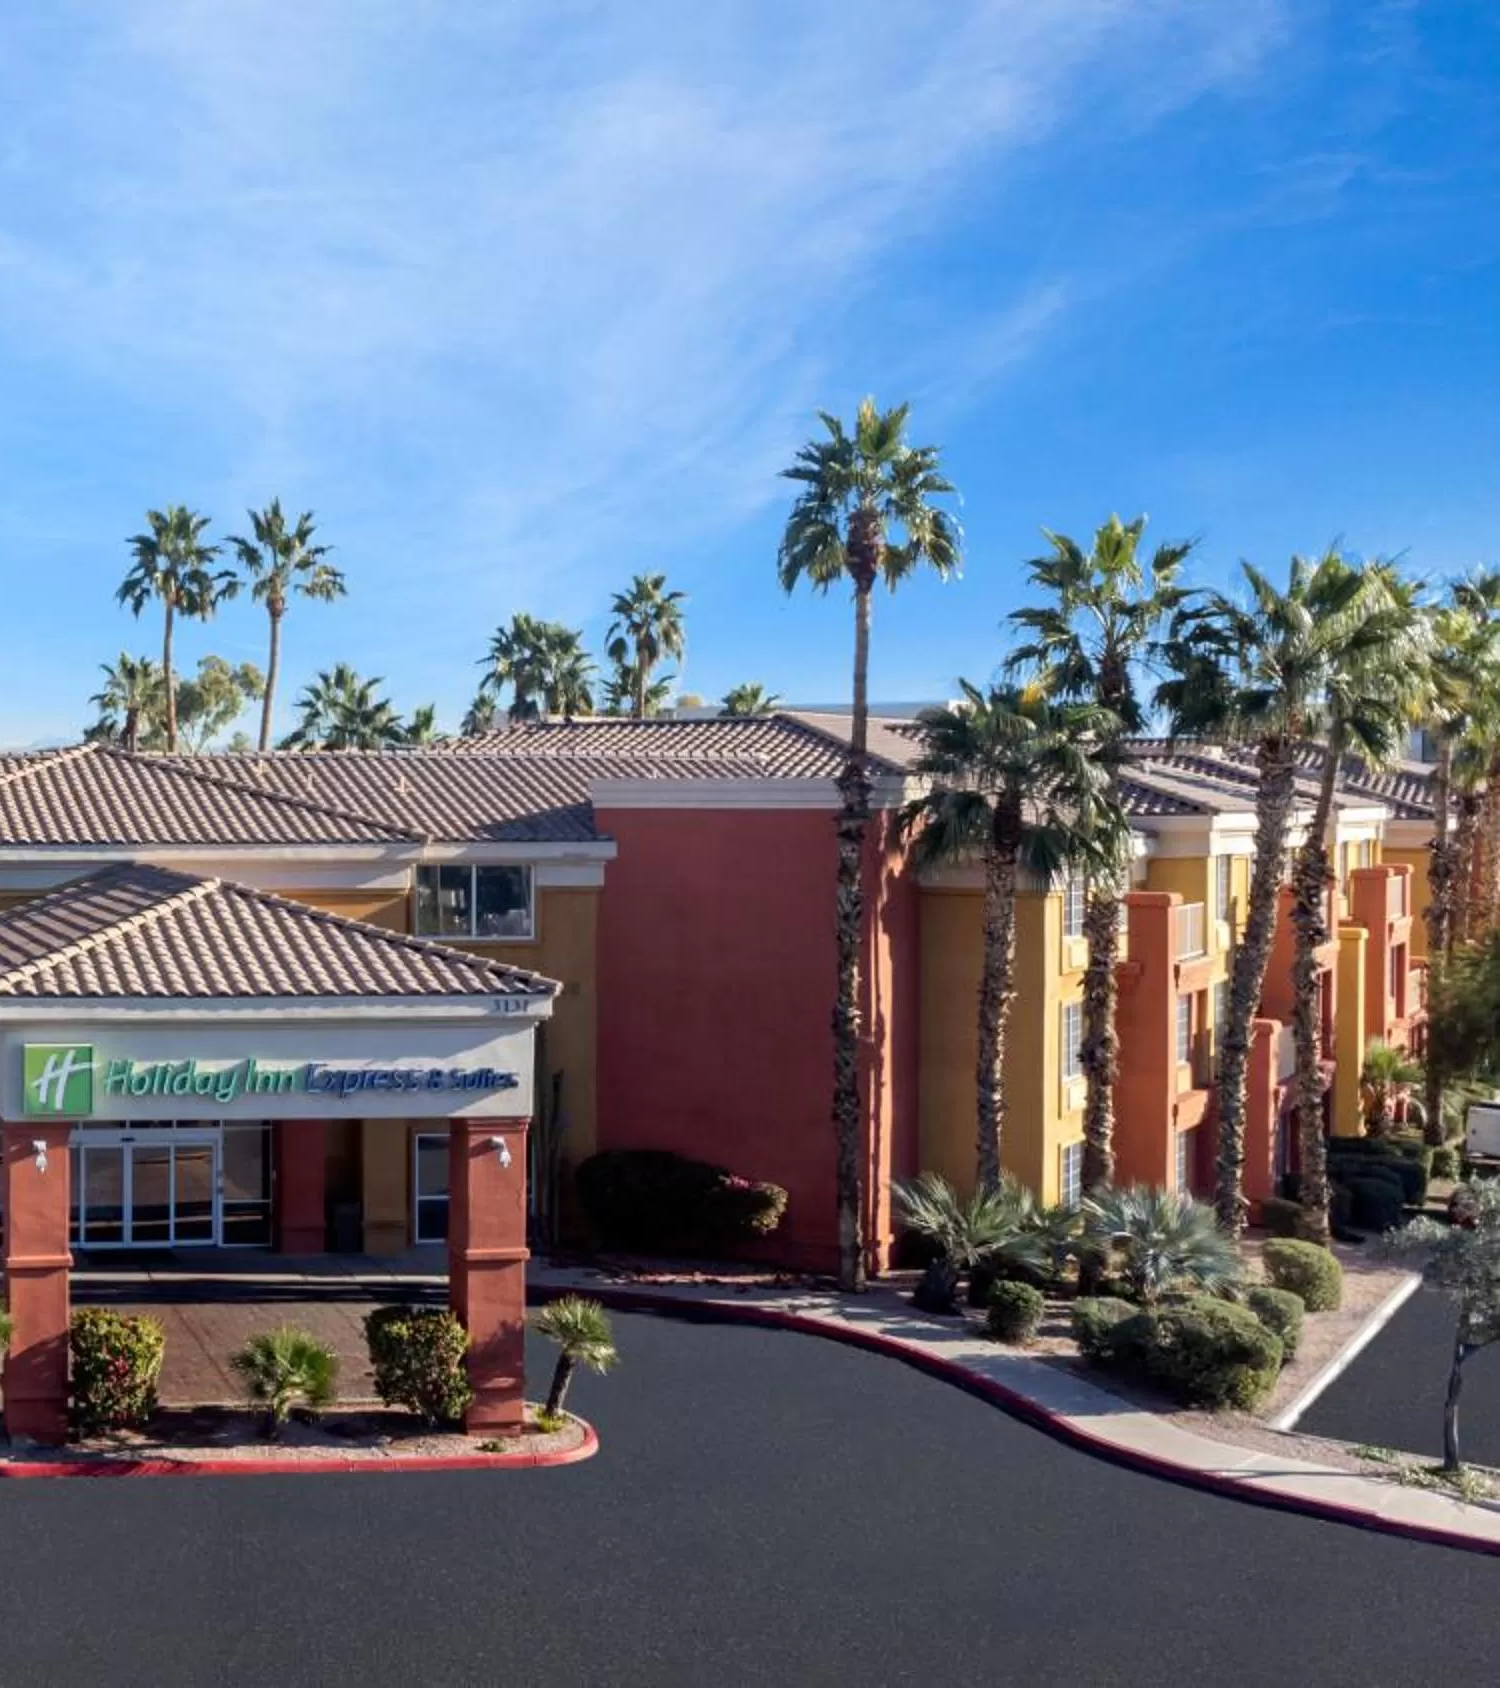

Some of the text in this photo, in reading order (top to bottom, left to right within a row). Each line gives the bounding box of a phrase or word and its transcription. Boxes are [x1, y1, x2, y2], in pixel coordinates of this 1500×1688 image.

[104, 1056, 238, 1103] Holiday
[245, 1055, 296, 1092] Inn
[307, 1060, 427, 1098] Express
[450, 1067, 519, 1090] Suites
